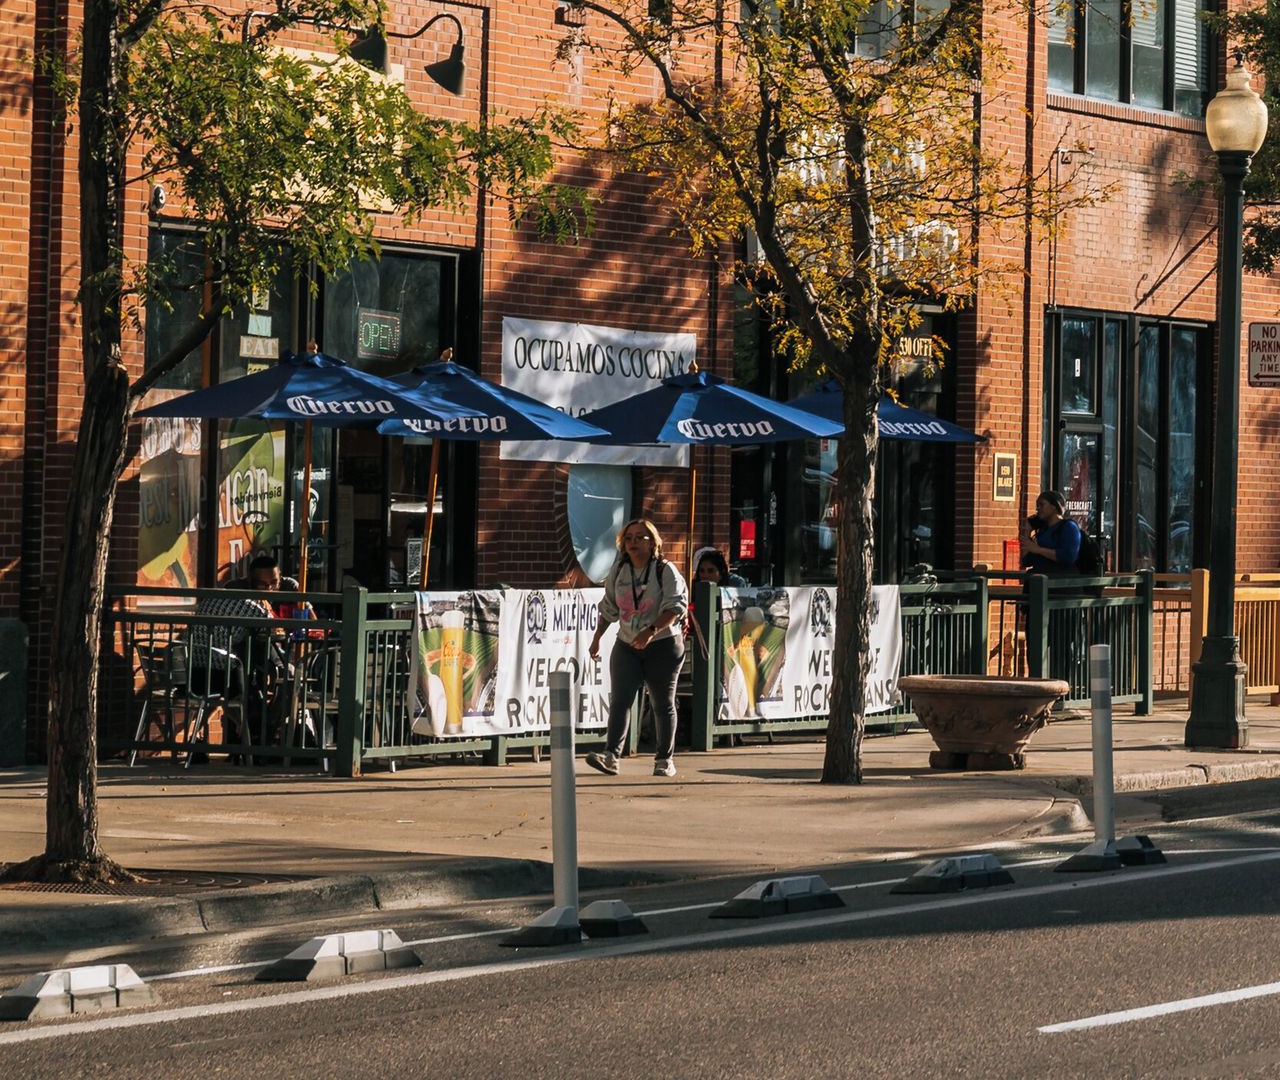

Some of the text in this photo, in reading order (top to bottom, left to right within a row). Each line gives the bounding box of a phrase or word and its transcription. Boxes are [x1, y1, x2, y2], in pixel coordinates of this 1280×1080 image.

[361, 322, 399, 351] OPEN
[1262, 326, 1277, 339] NO
[514, 336, 686, 380] OCUPAMOS COCINA
[1260, 364, 1279, 372] TIME
[1261, 354, 1278, 362] ANY
[286, 395, 395, 416] Cuervo
[403, 416, 508, 433] Cuervo
[677, 418, 774, 440] Cuervo
[553, 602, 577, 632] MILE
[579, 601, 599, 631] HIG
[867, 678, 894, 706] ANS
[578, 690, 609, 723] FAN
